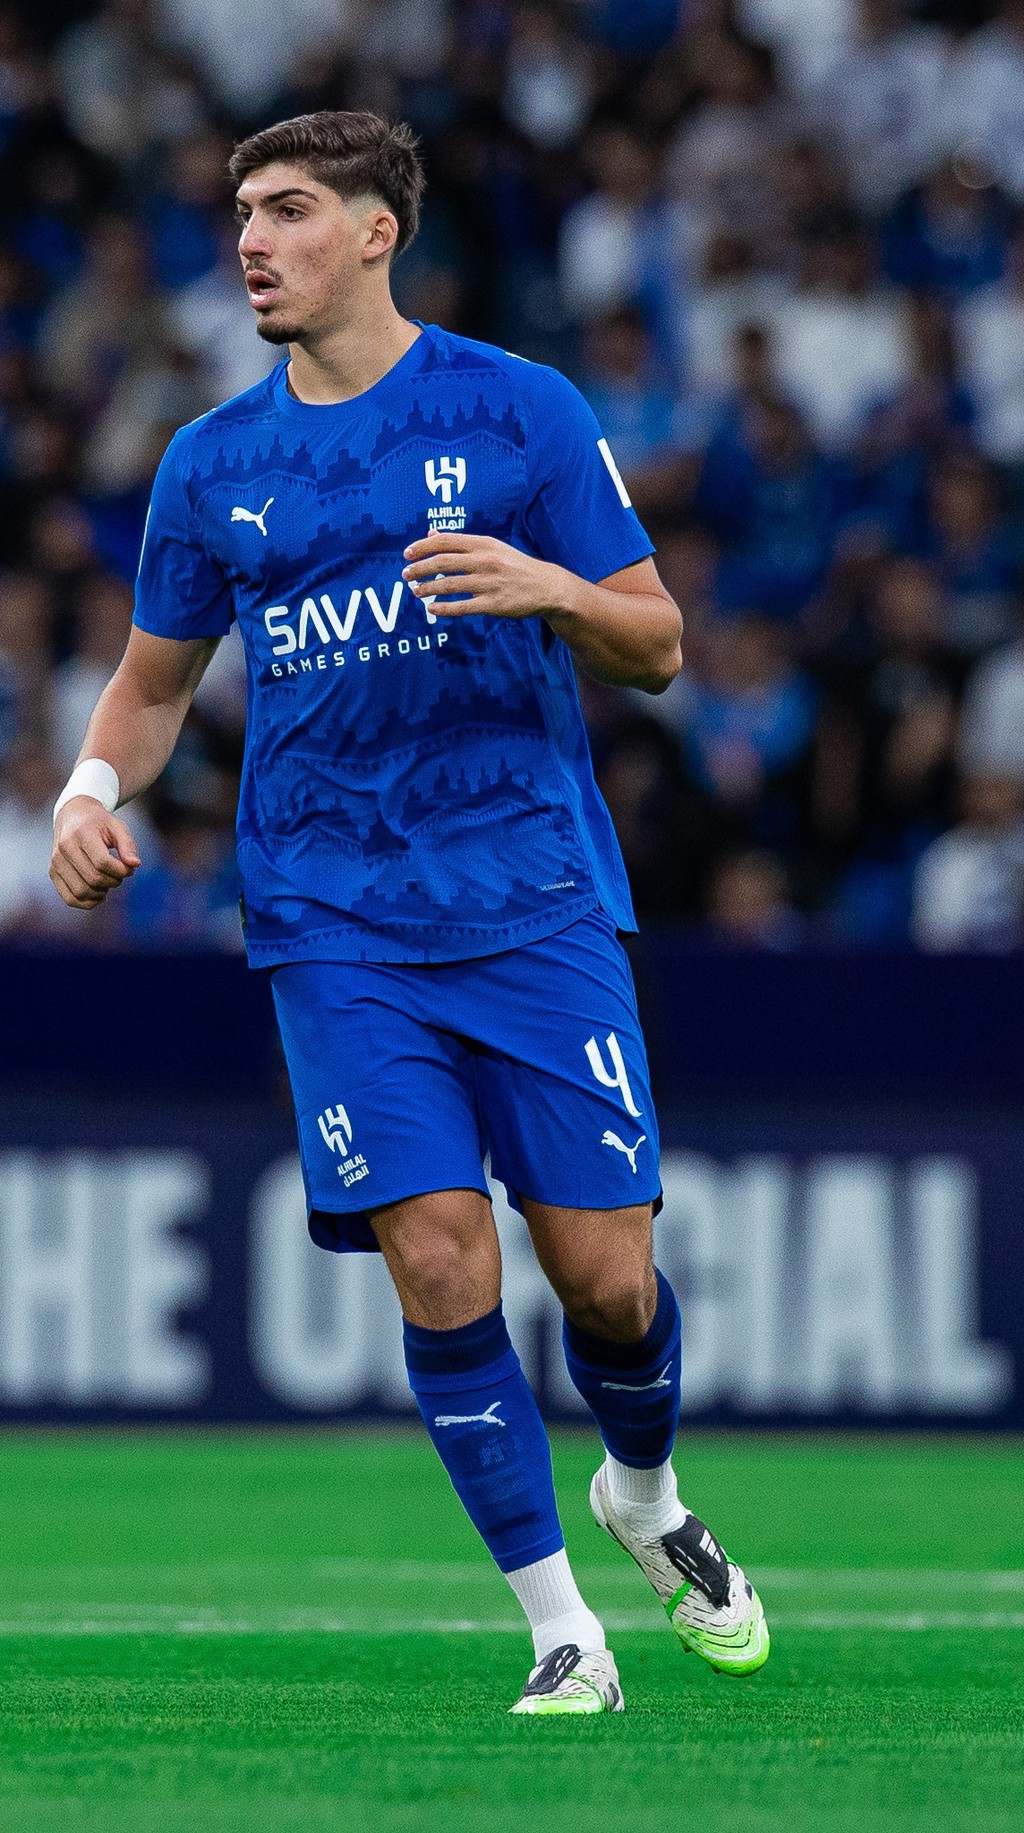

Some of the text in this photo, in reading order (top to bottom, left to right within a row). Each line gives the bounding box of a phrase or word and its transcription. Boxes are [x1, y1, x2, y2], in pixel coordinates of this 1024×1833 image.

[427, 506, 467, 519] ALHILAL
[271, 632, 449, 677] GAMES GROUP
[584, 1031, 643, 1118] 4
[337, 1153, 367, 1177] ALHILAL
